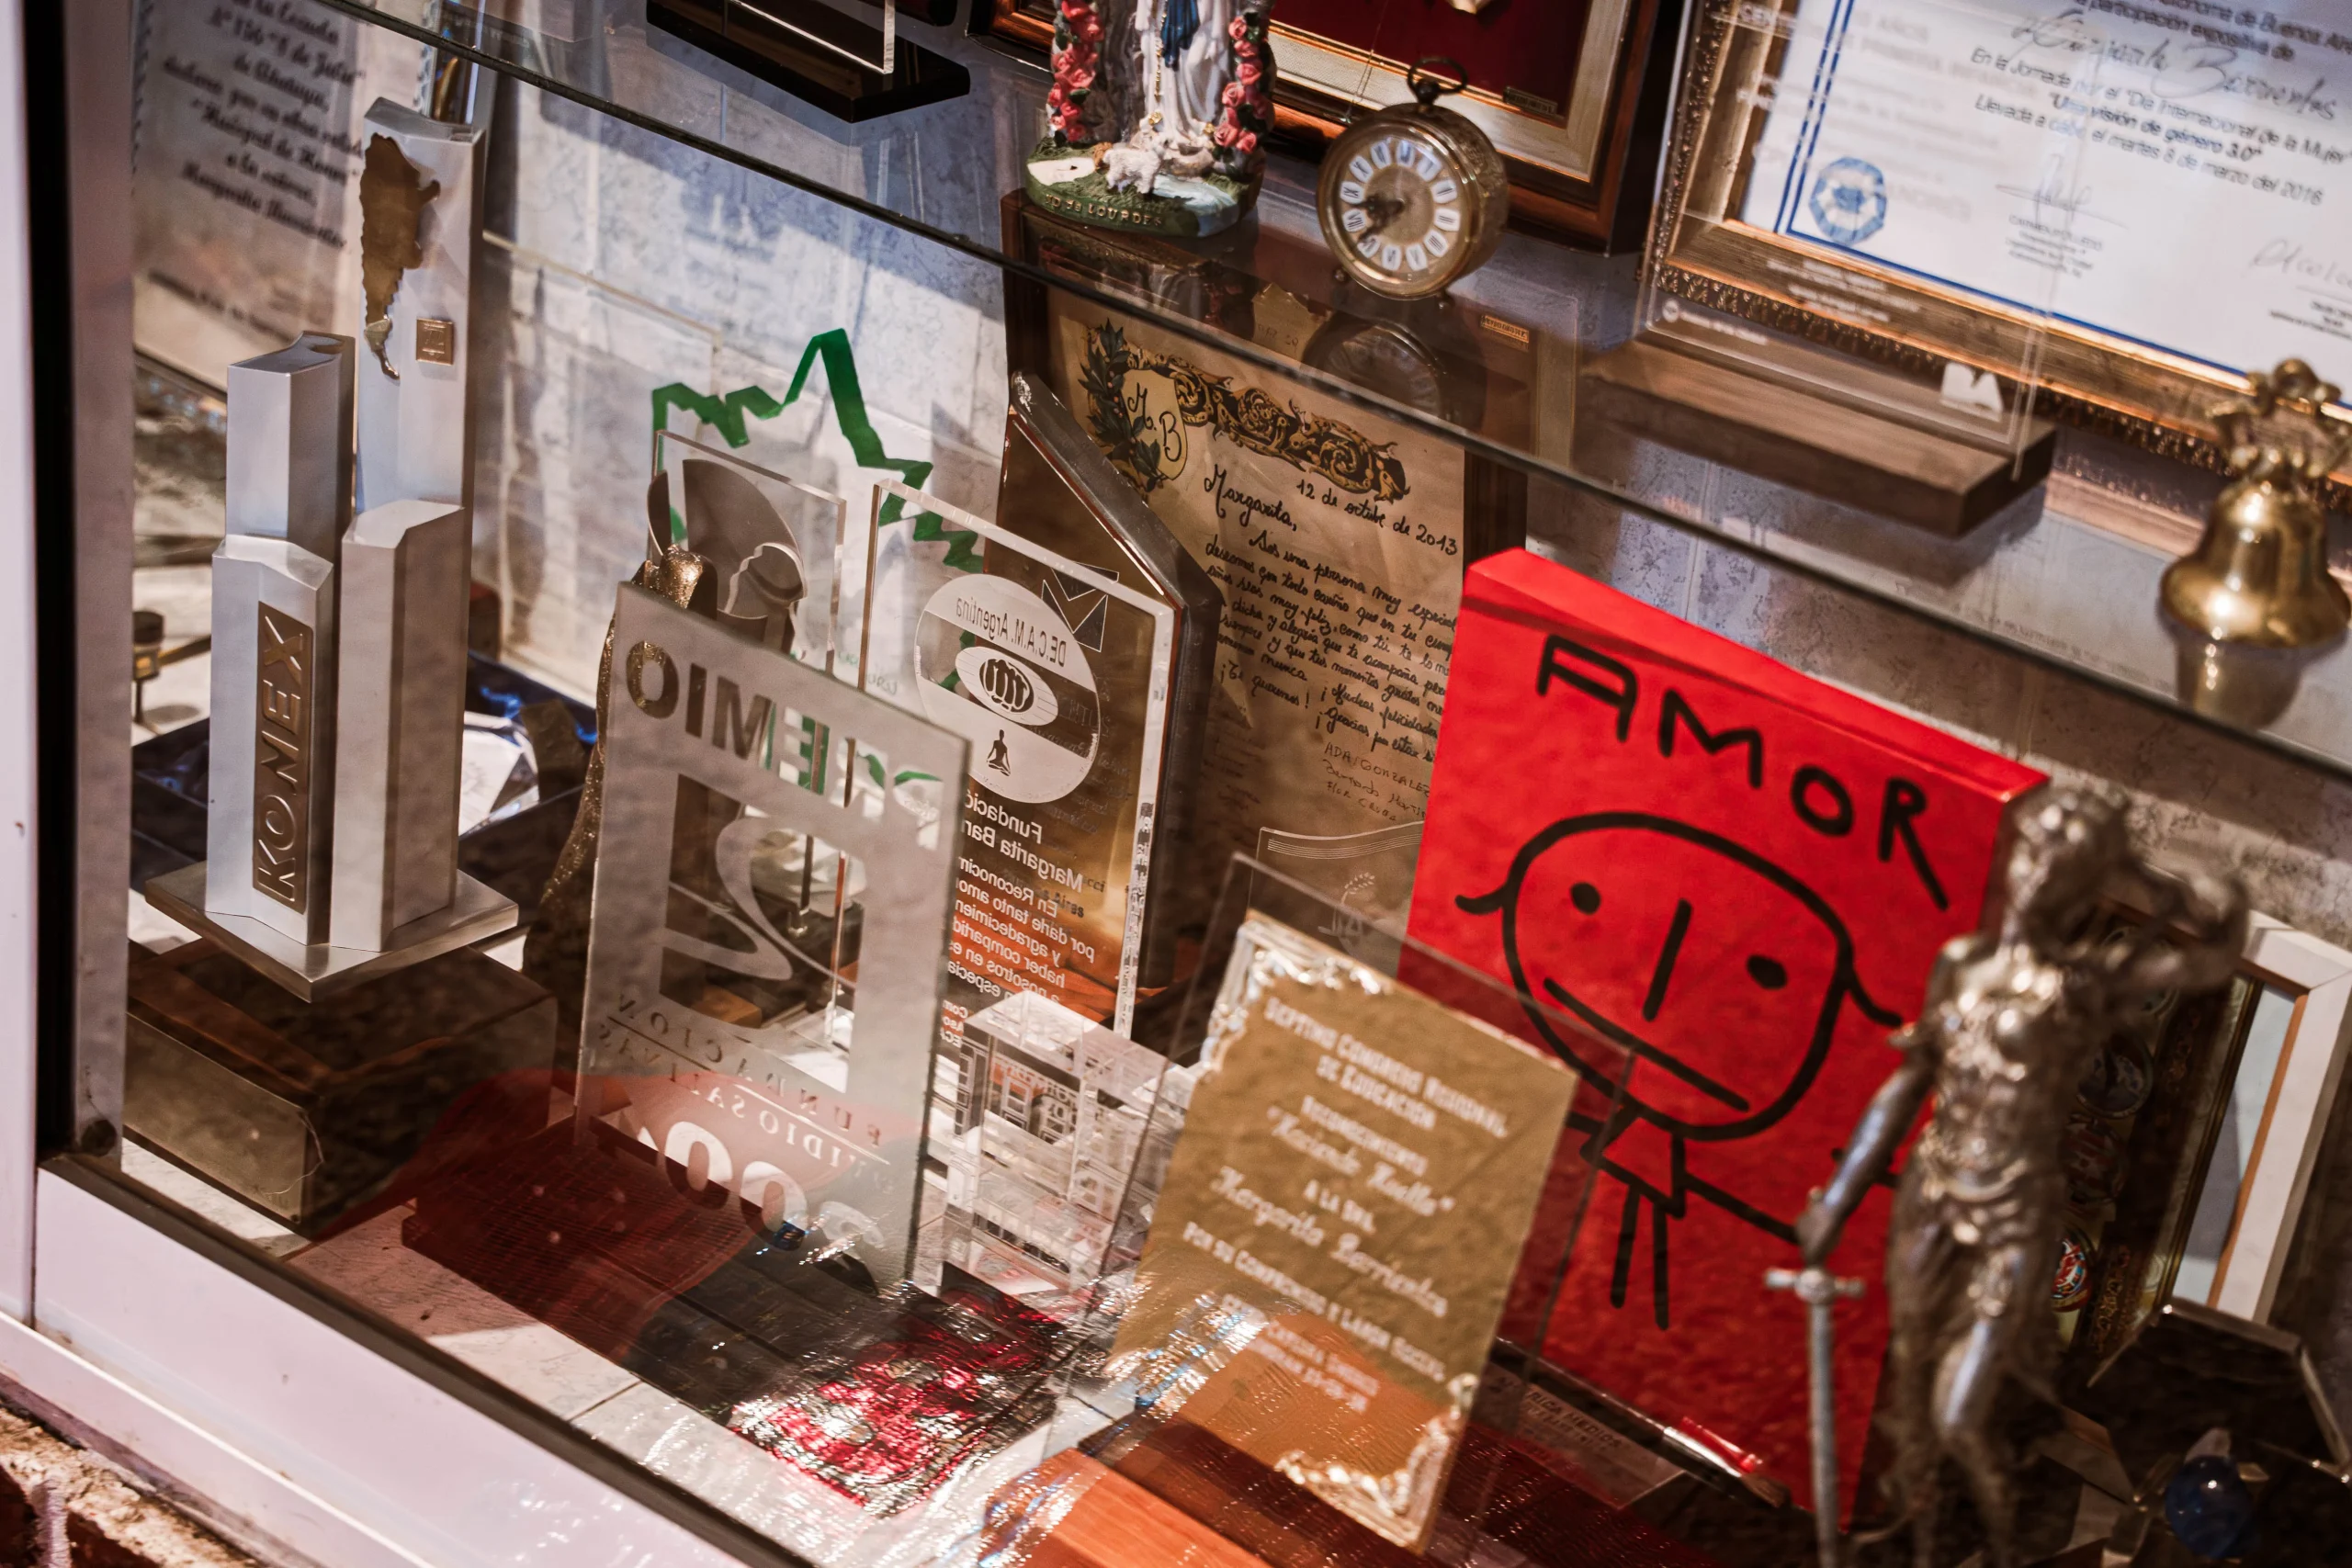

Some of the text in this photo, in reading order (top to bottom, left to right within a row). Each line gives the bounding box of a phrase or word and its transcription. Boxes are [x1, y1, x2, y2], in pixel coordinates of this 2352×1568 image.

[1296, 479, 1316, 501] 12
[1321, 489, 1338, 507] de
[1393, 515, 1410, 536] de
[1416, 524, 1459, 556] 2013
[1314, 562, 1367, 594] persona
[1372, 585, 1402, 615] muy
[258, 615, 303, 903] KONEX
[1535, 632, 1951, 913] AMOR
